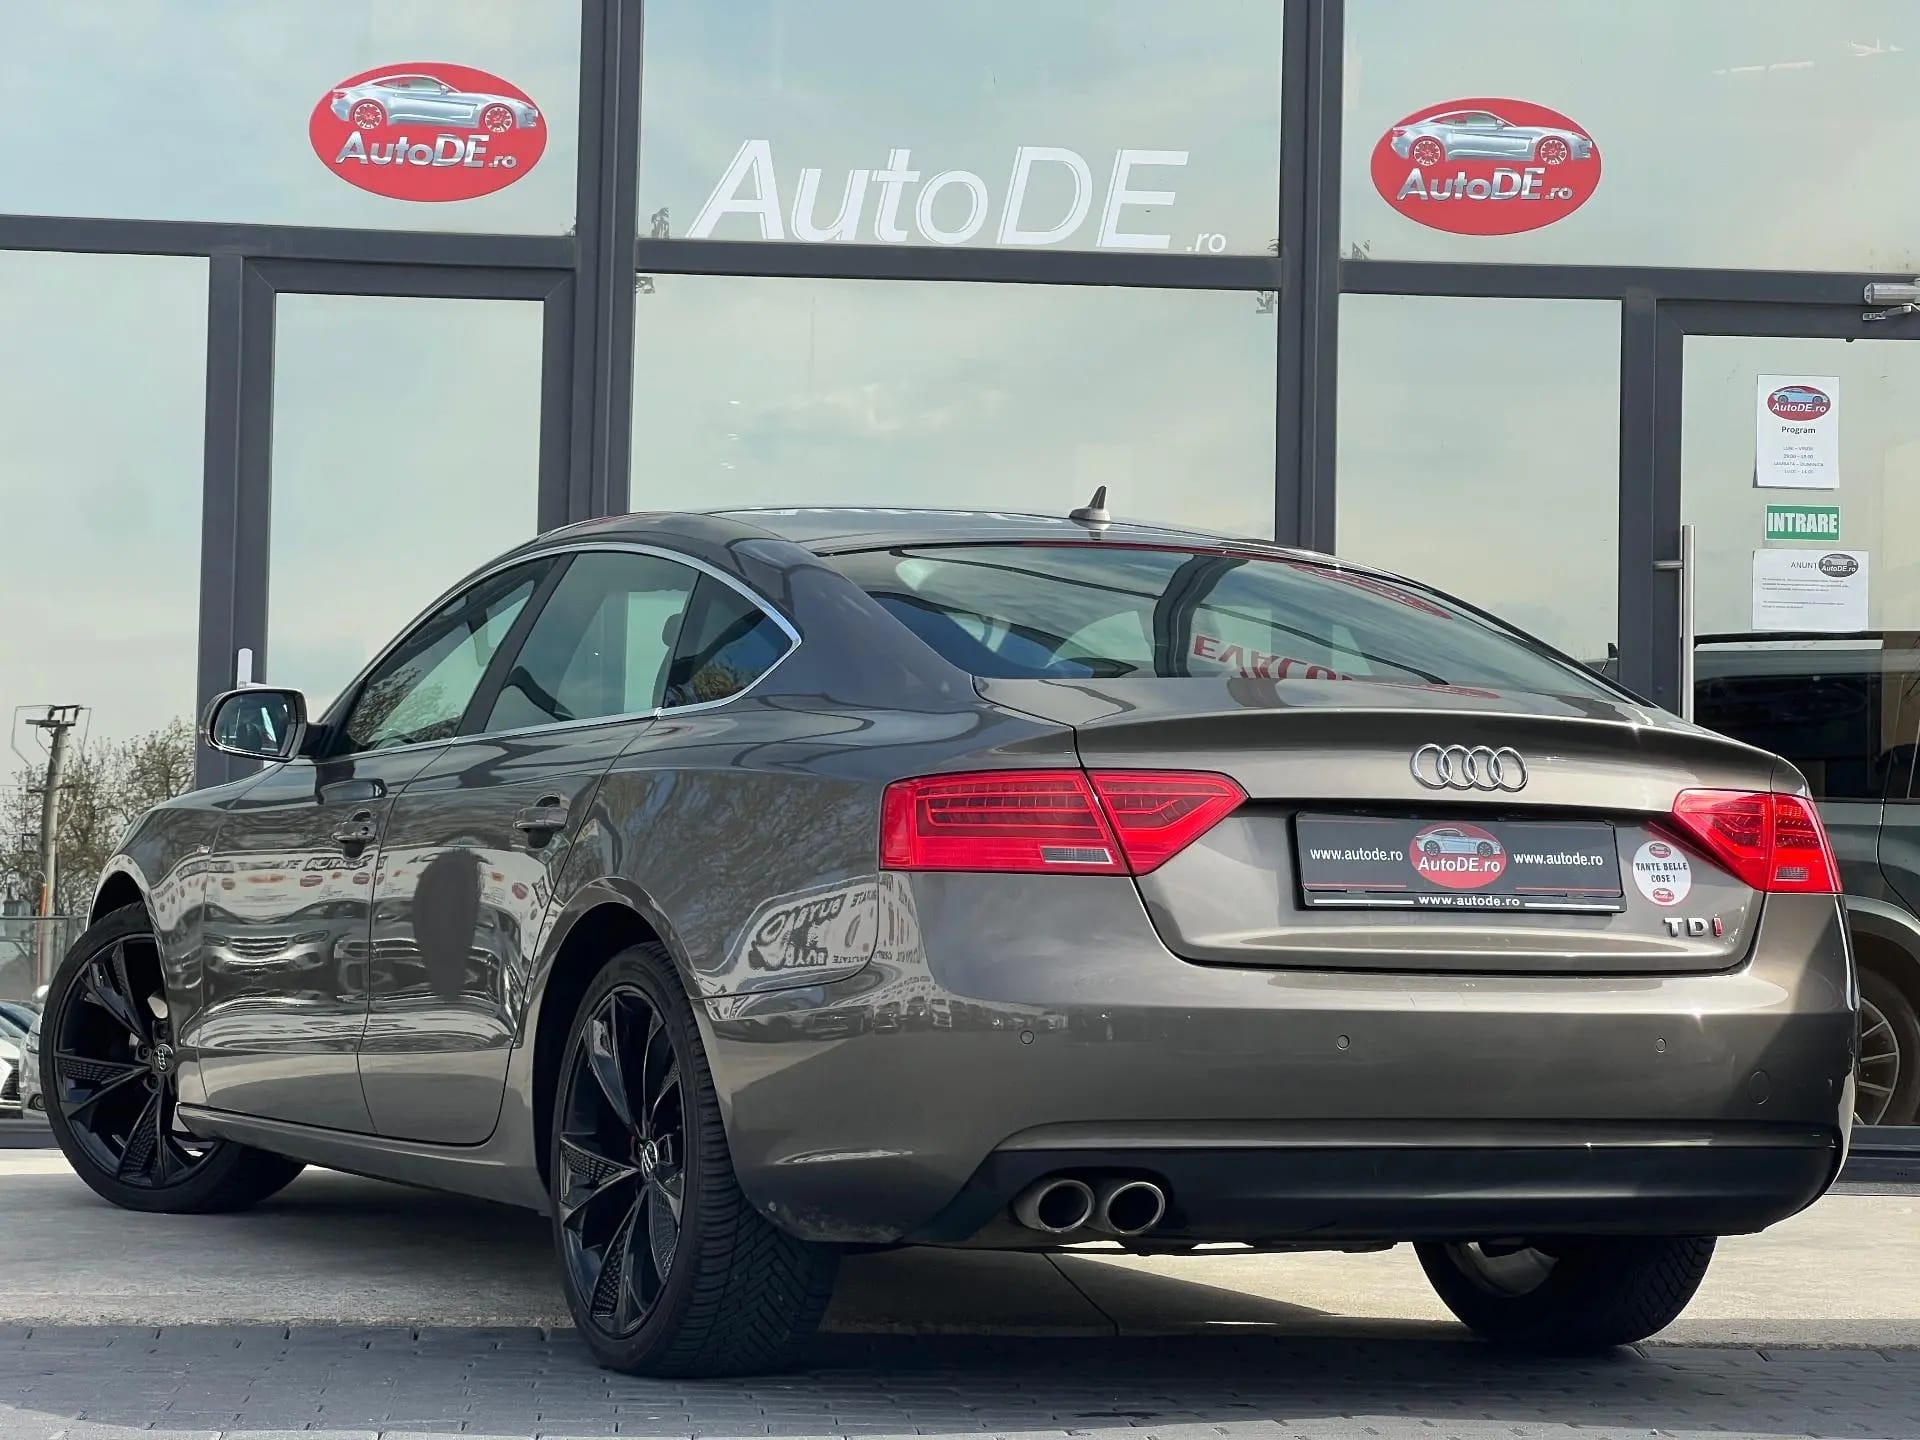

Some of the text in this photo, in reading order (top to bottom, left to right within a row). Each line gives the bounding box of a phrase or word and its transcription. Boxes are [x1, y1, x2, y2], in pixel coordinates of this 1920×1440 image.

[335, 131, 518, 168] AutoDE.ro
[1396, 167, 1573, 201] AutoDE.ro
[1772, 403, 1827, 413] AutoDE.ro
[1781, 426, 1816, 435] Program
[1767, 512, 1838, 534] INTRARE
[1310, 847, 1604, 873] www.autode.ro AutoDE.ro www.autode.ro
[1635, 862, 1688, 872] TANTE BELLE
[1651, 874, 1671, 883] COSE
[1418, 895, 1520, 906] www.autode.ro
